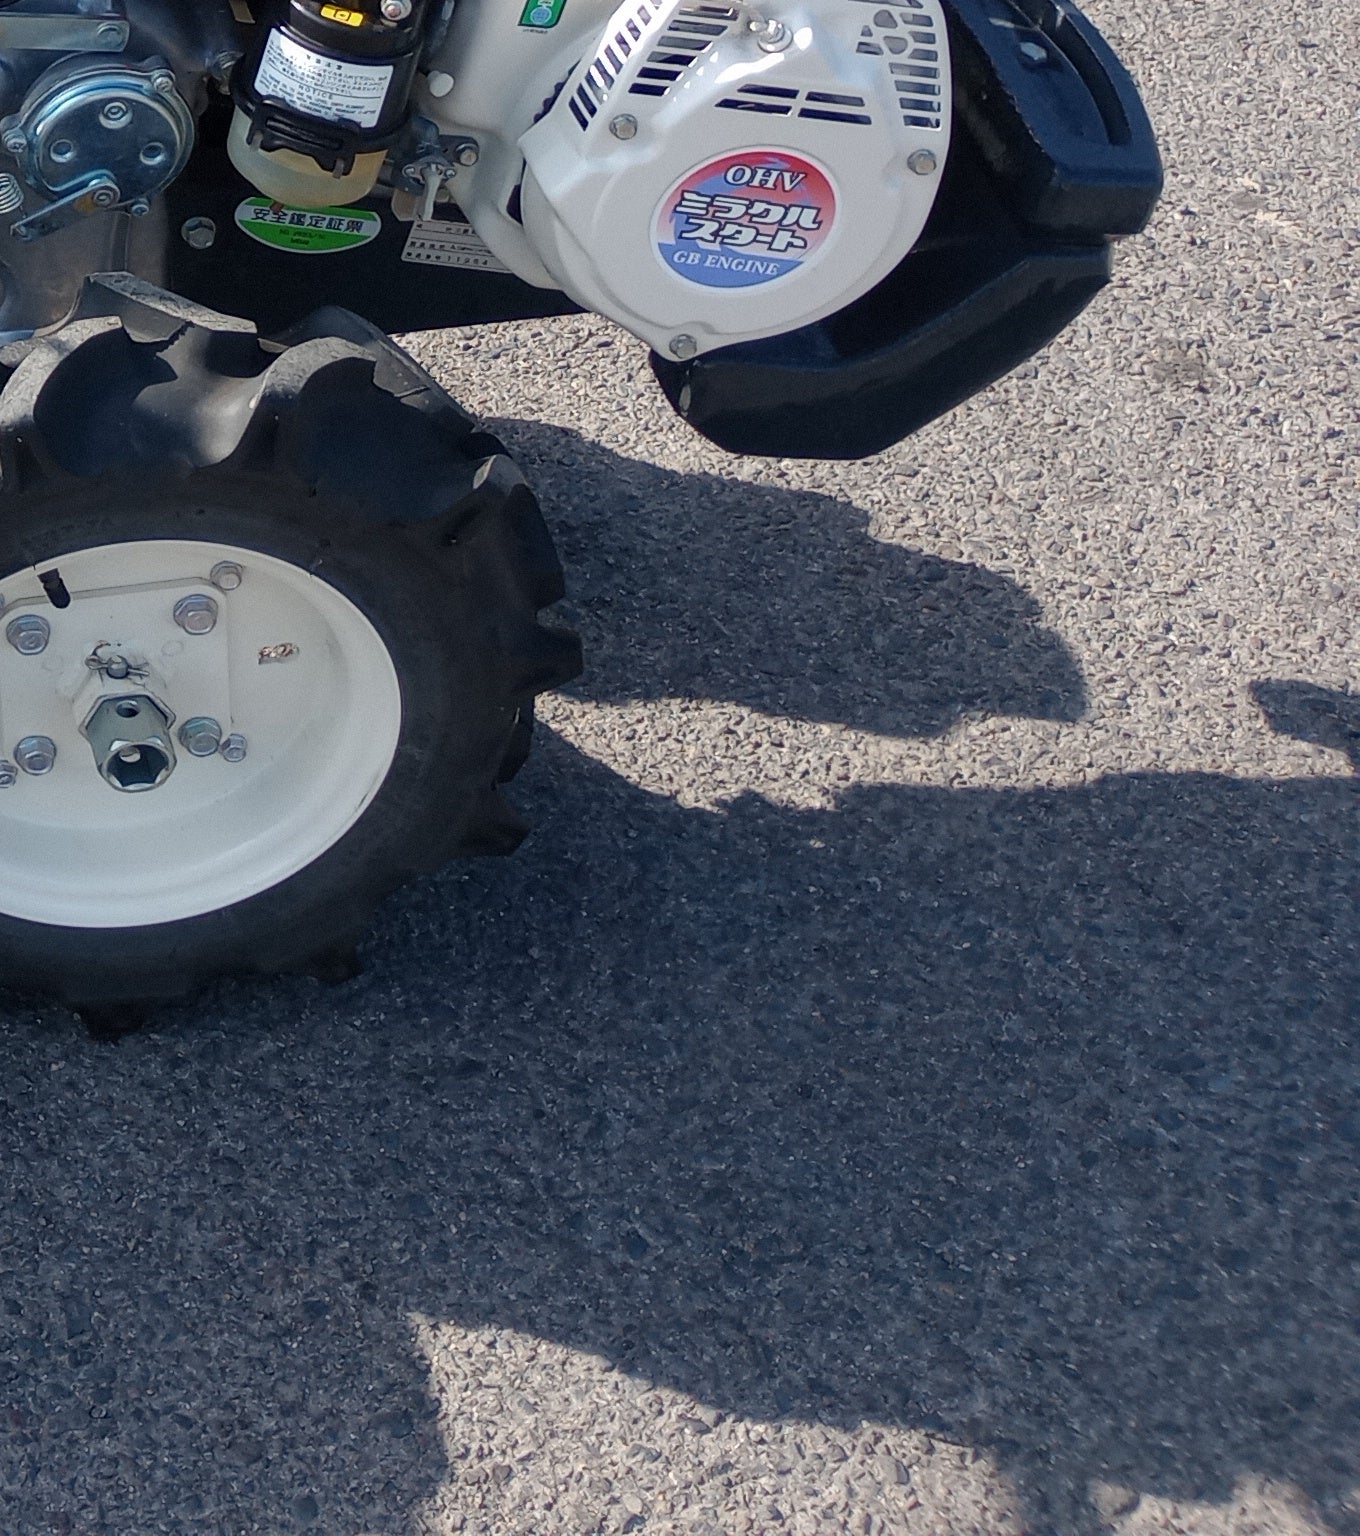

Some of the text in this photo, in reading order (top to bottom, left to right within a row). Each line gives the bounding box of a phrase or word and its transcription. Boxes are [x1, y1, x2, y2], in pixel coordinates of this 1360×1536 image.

[725, 163, 807, 192] OHV
[675, 190, 823, 230] ミラクル
[677, 216, 807, 252] スタート
[672, 250, 780, 276] GB ENGINE
